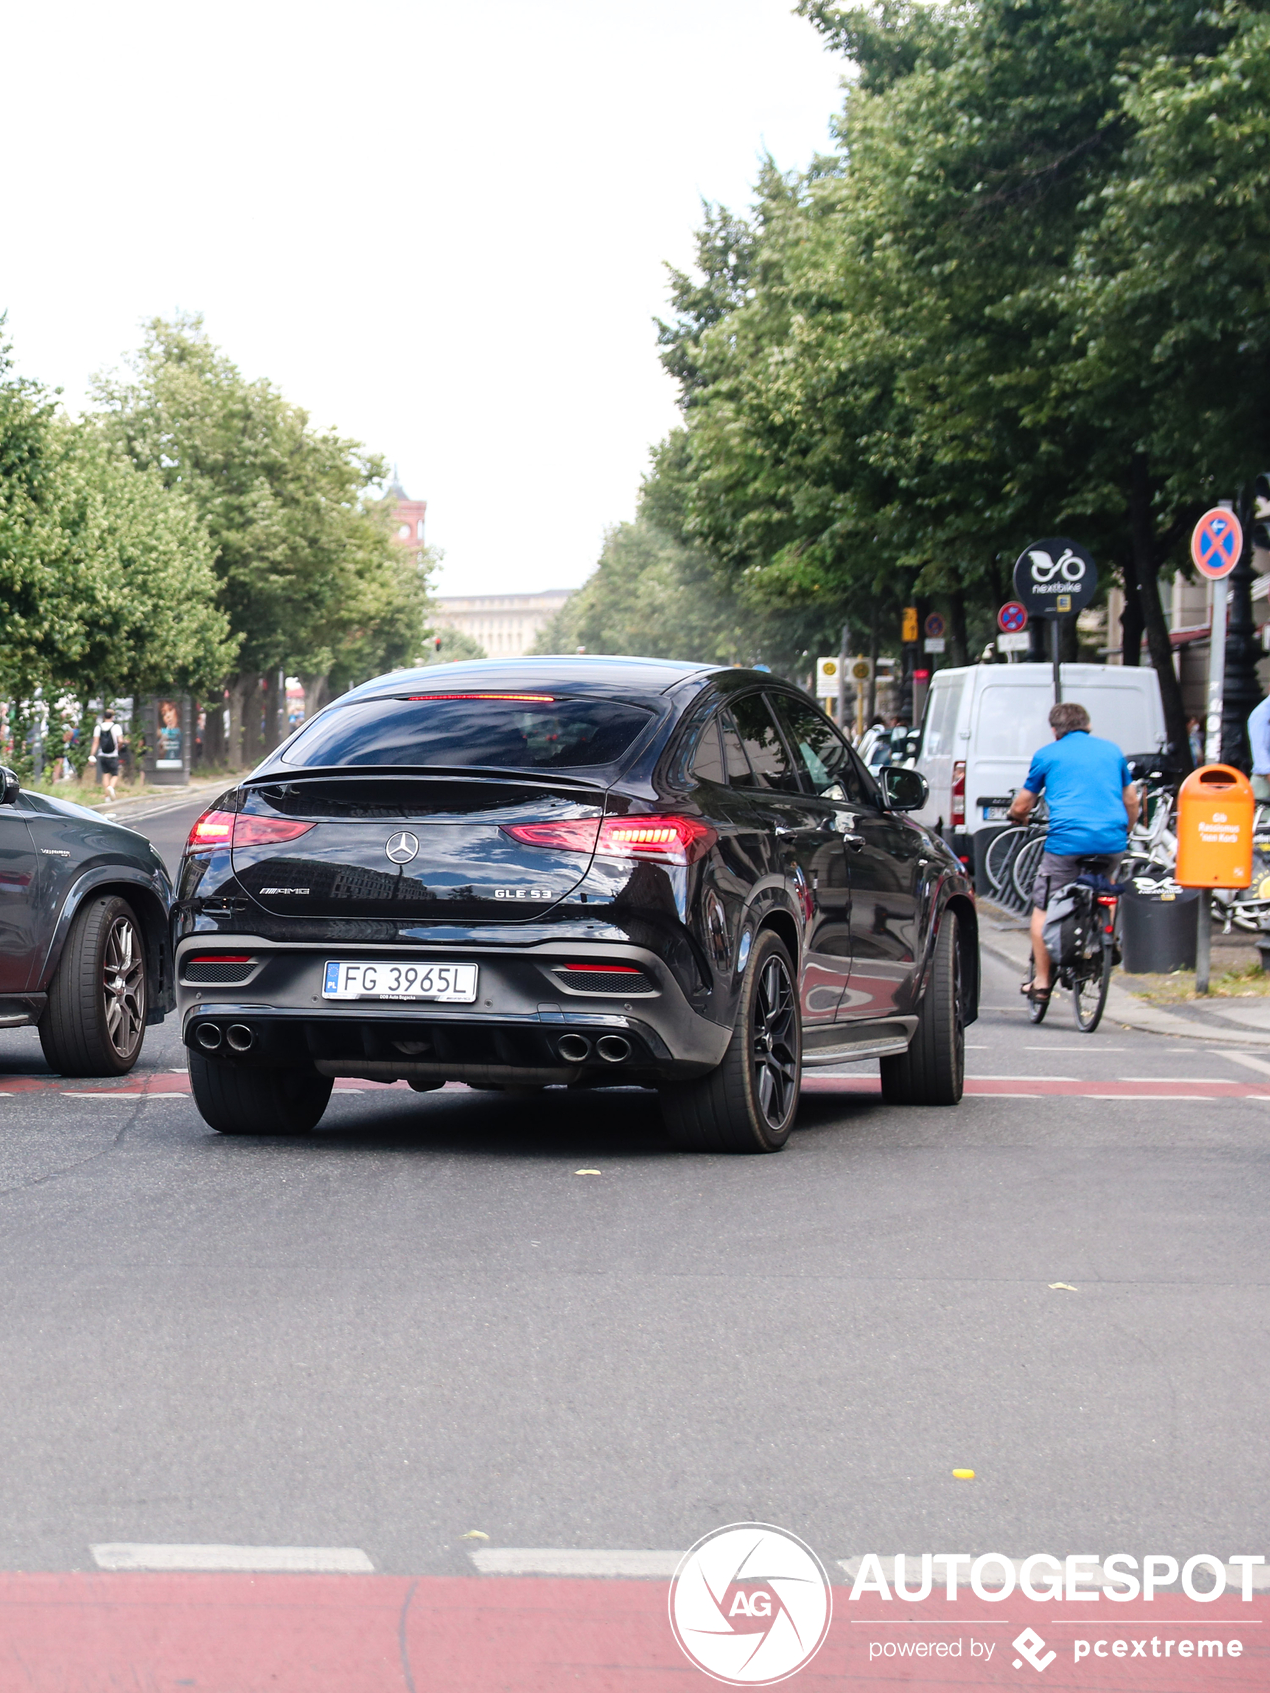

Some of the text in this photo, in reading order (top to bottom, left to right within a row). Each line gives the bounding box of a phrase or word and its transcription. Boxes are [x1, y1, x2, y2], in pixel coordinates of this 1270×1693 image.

[1032, 580, 1082, 594] nextbike
[494, 889, 552, 899] GLE 53
[327, 981, 337, 989] PL
[344, 966, 467, 994] FG 3965L
